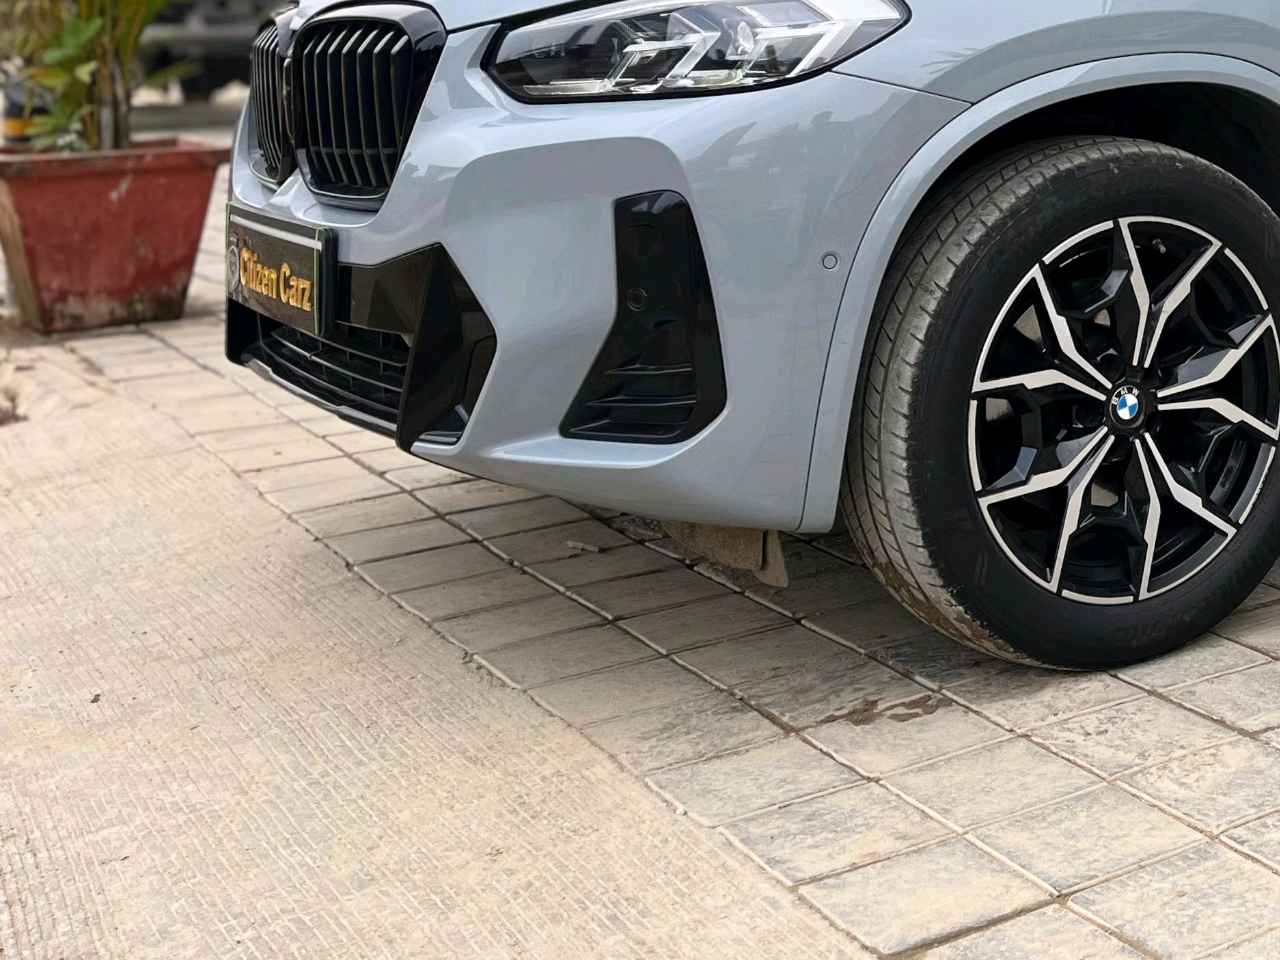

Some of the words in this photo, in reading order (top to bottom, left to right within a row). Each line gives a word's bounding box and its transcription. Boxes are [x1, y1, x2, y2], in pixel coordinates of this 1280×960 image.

[240, 248, 277, 299] Citizen
[280, 262, 312, 311] Carz
[1111, 386, 1140, 405] BMW
